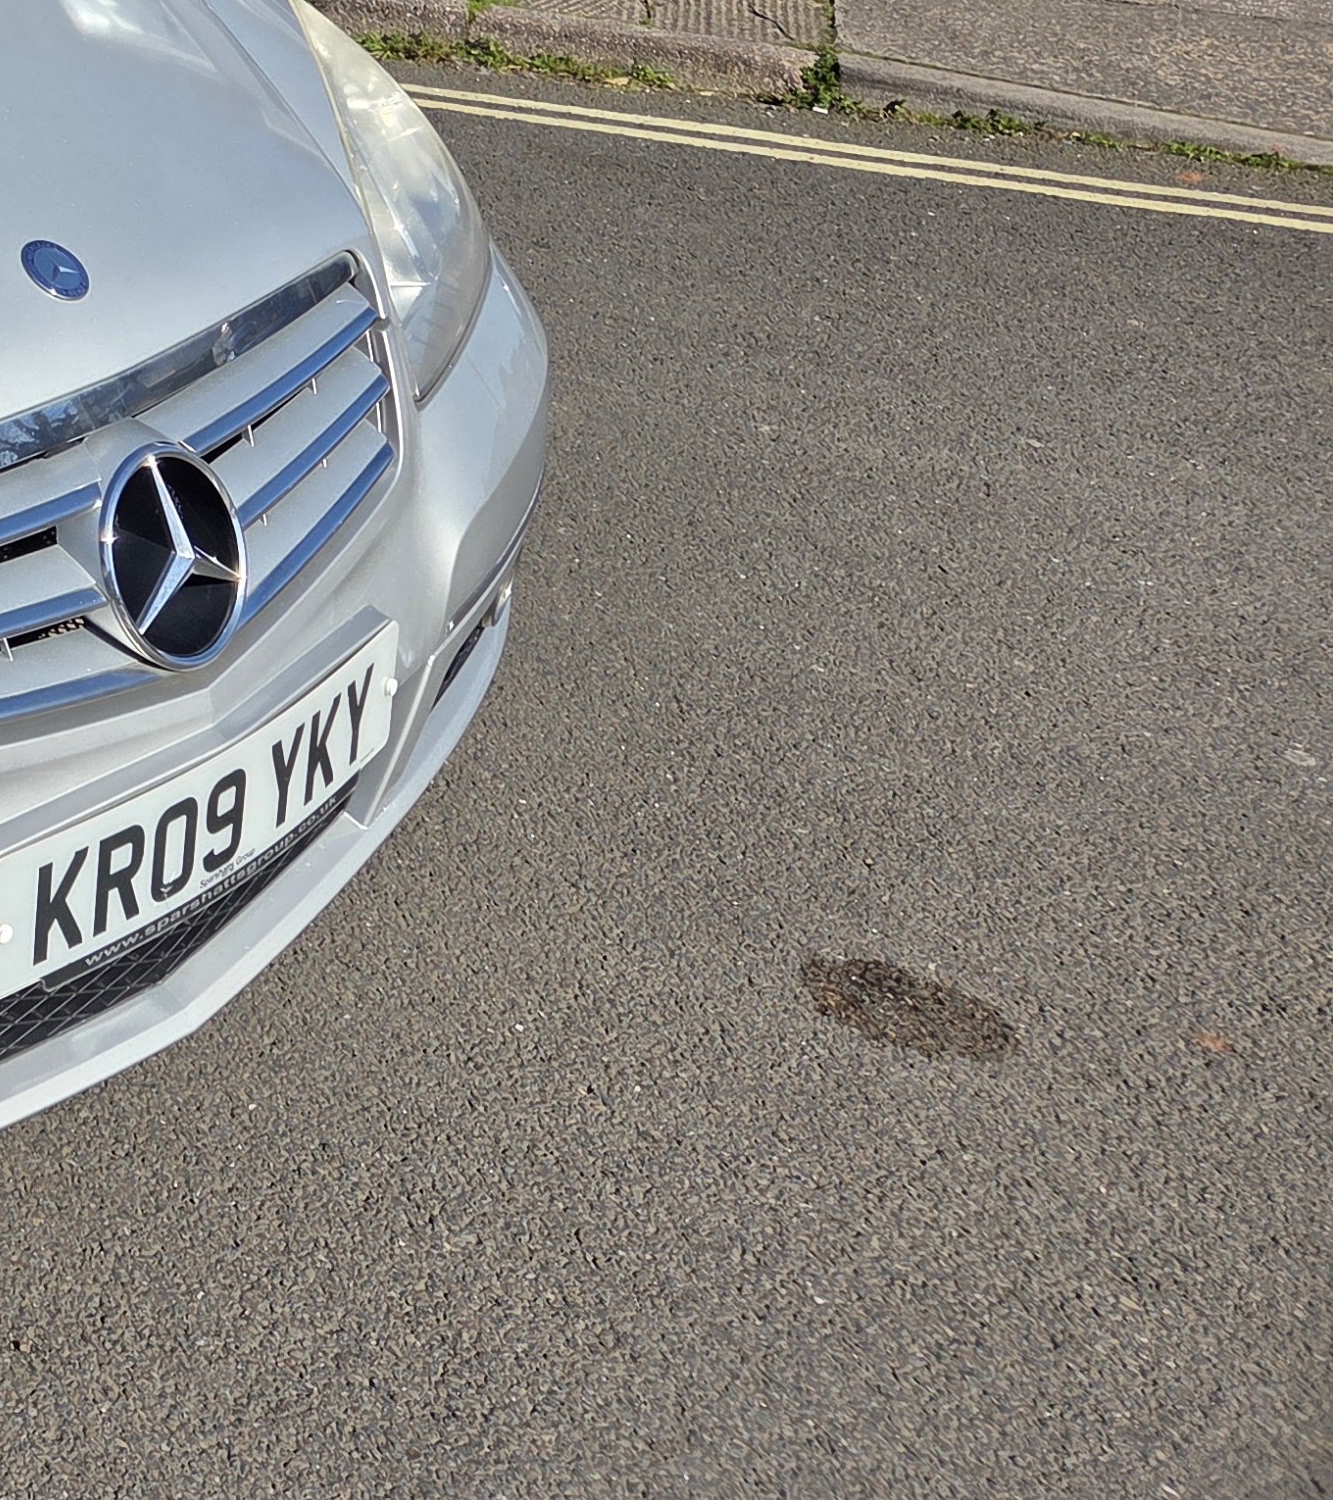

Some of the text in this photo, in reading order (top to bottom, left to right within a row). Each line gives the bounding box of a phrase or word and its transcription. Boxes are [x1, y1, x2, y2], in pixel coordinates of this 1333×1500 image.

[33, 662, 375, 967] KR09 YKY
[84, 796, 338, 967] www.sparshattsgroup.co.uk
